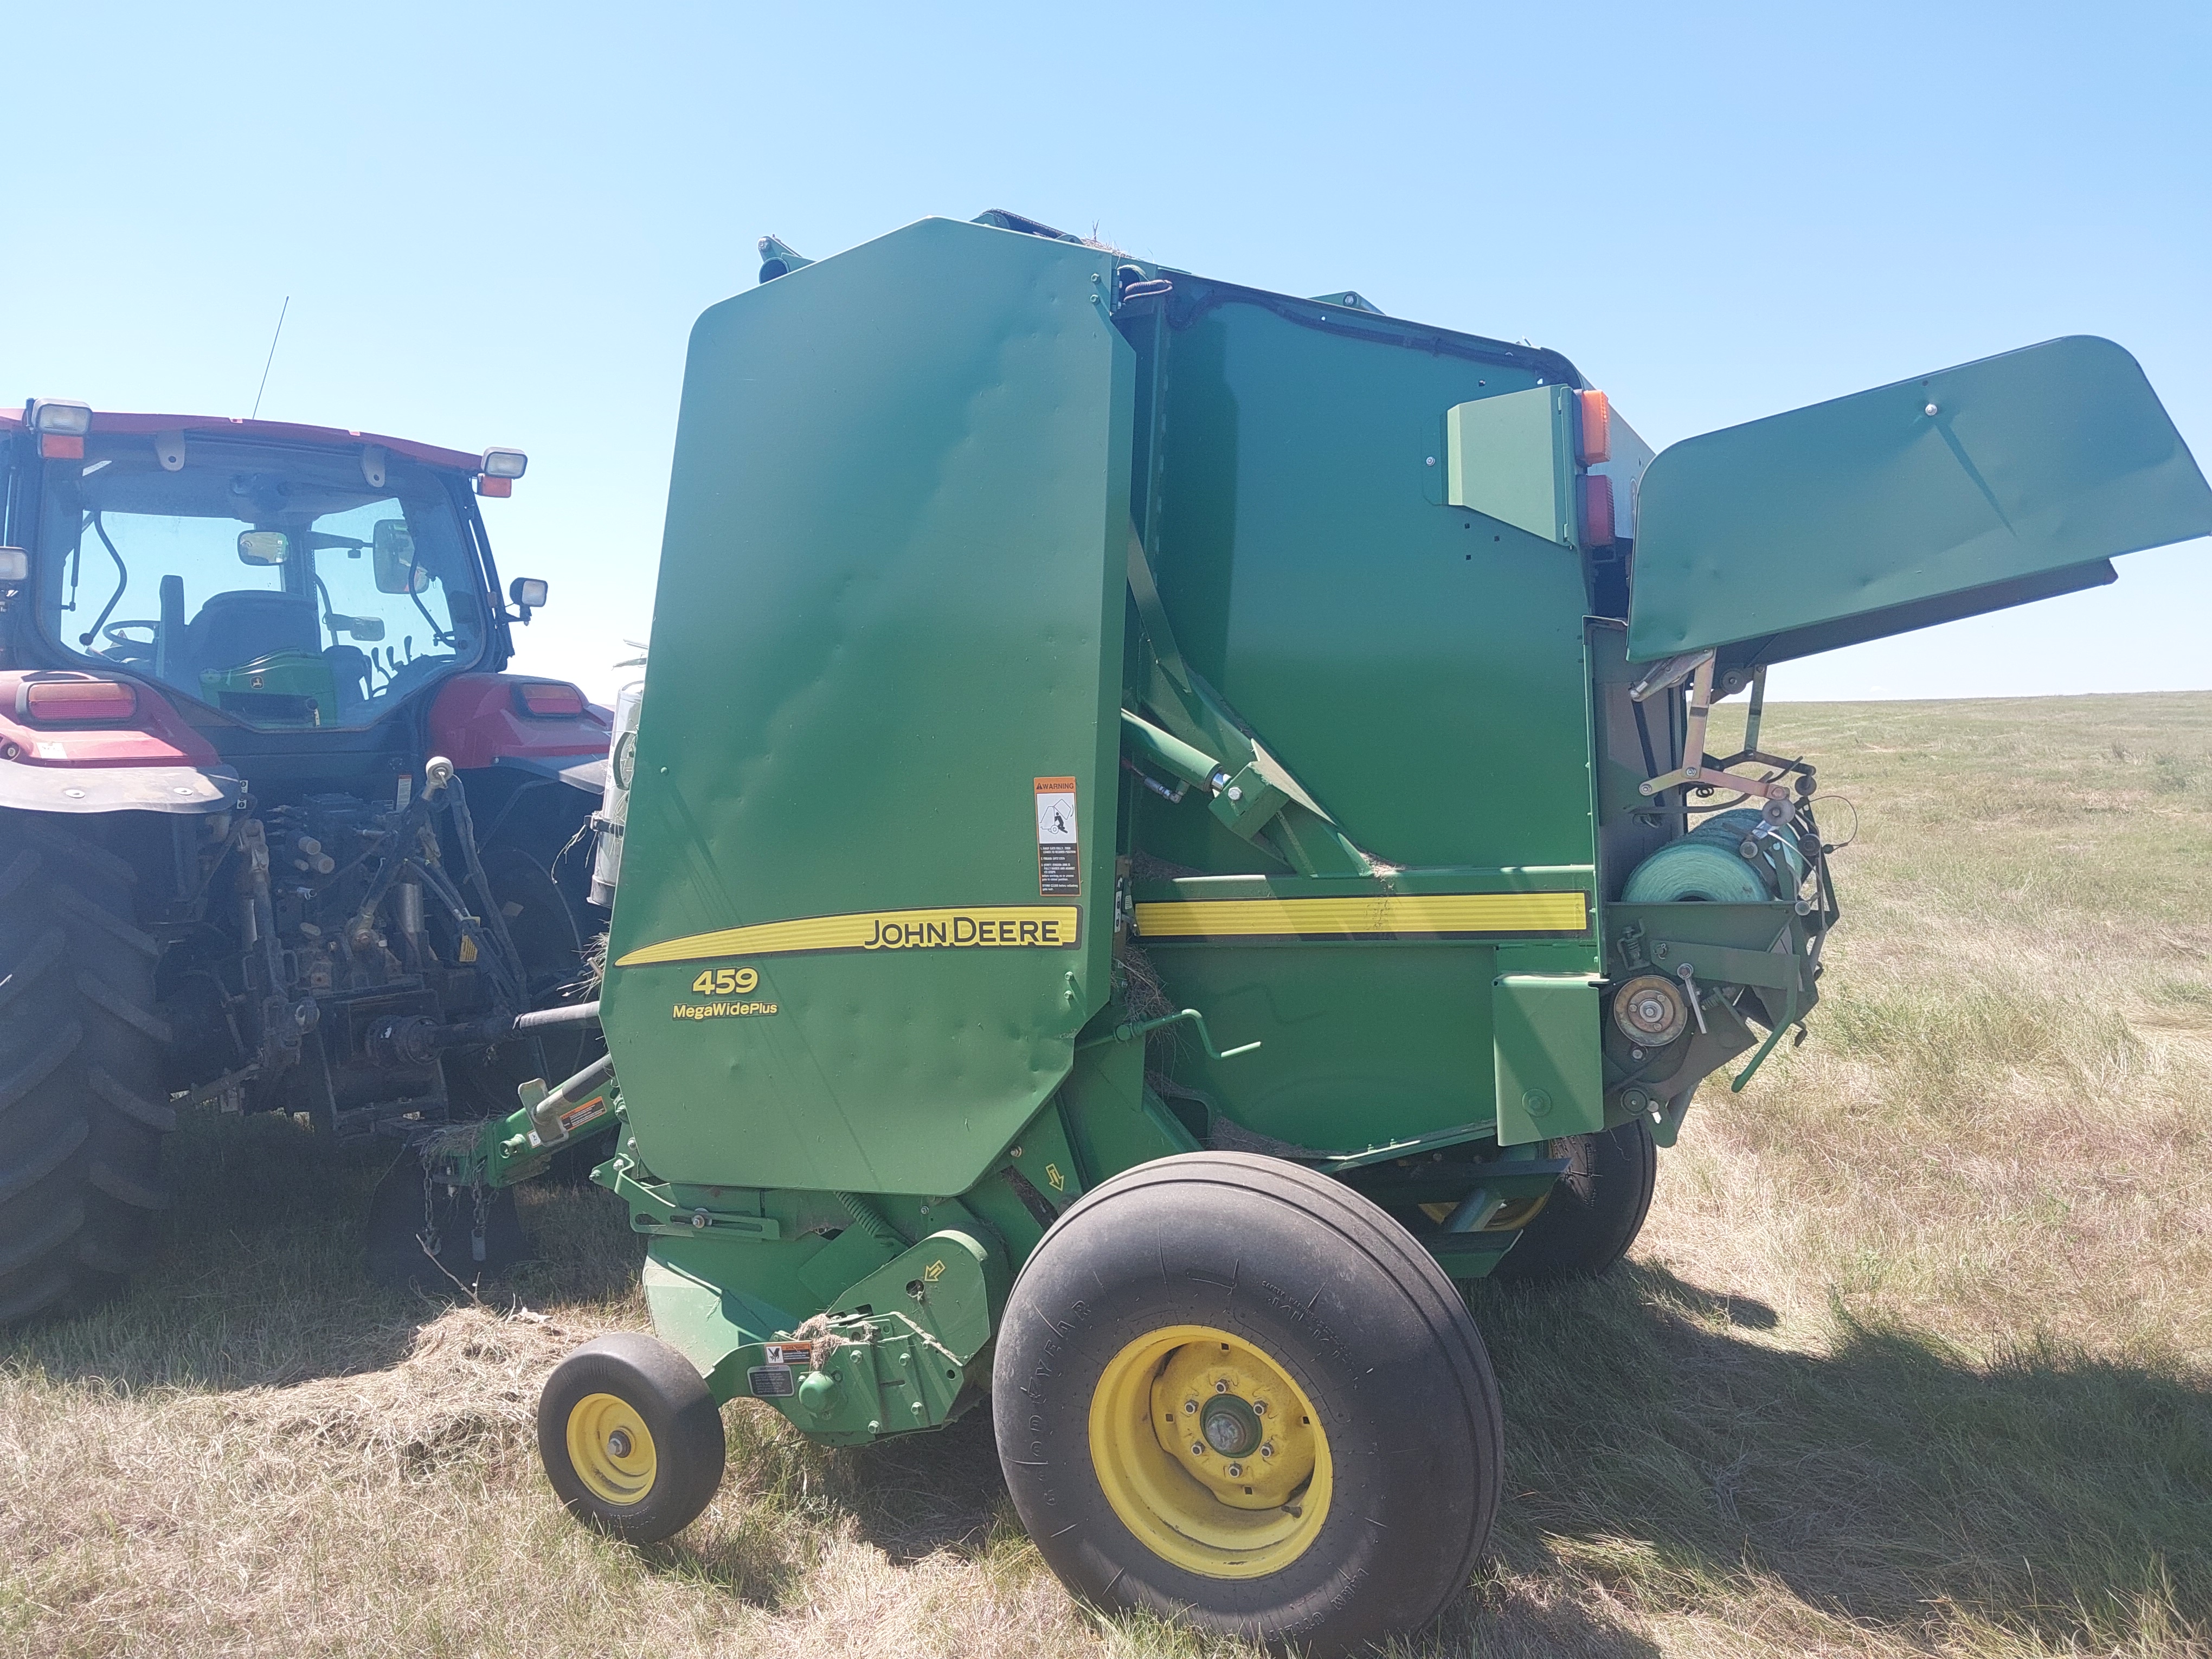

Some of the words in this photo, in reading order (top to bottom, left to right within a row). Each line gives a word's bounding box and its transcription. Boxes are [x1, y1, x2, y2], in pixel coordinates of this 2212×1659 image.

[864, 919, 946, 946] JOHN
[953, 916, 1060, 943] DEERE
[692, 967, 758, 995] 459
[672, 1002, 778, 1020] MegaWidePlus
